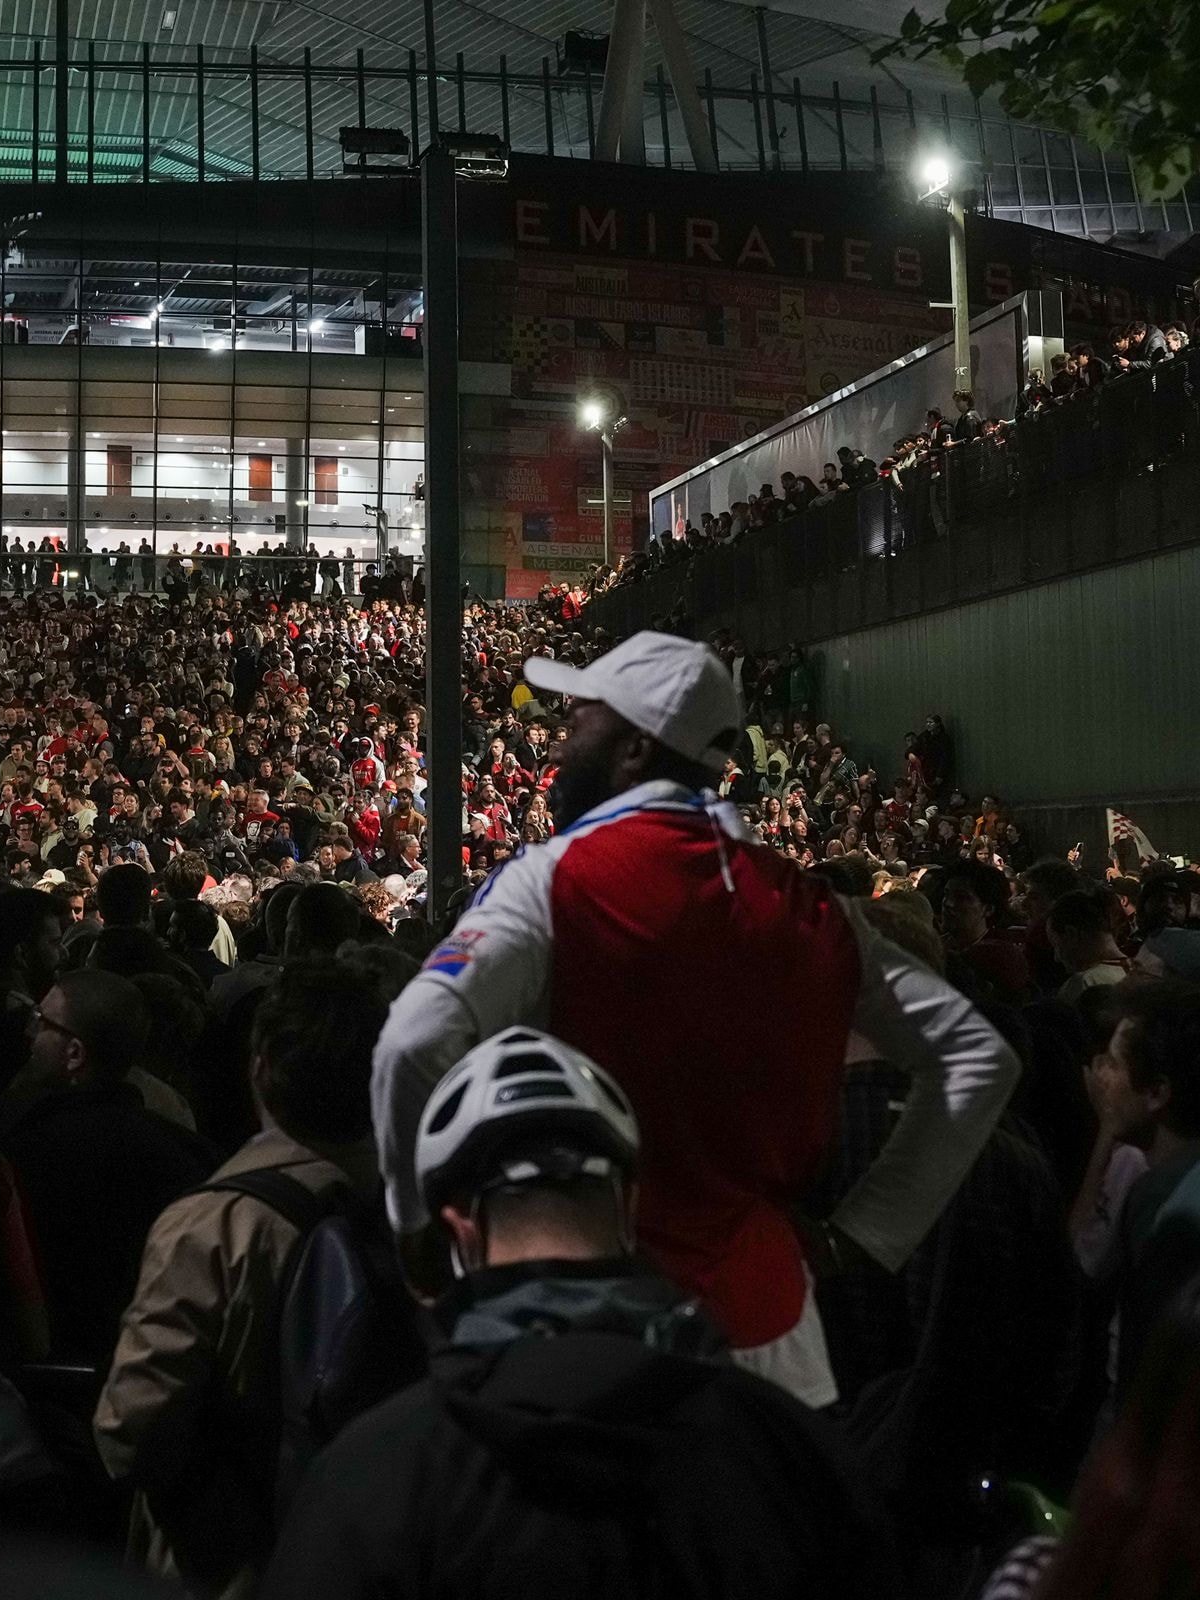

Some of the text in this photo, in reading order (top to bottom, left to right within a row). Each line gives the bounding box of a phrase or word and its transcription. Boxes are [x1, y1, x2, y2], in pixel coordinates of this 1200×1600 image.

[515, 198, 923, 288] EMIRATES
[809, 324, 893, 353] Arsenal
[580, 489, 630, 498] ARSNAL
[581, 509, 631, 517] VIETAM
[579, 534, 632, 544] GUNRS
[526, 543, 604, 557] ARSENAL
